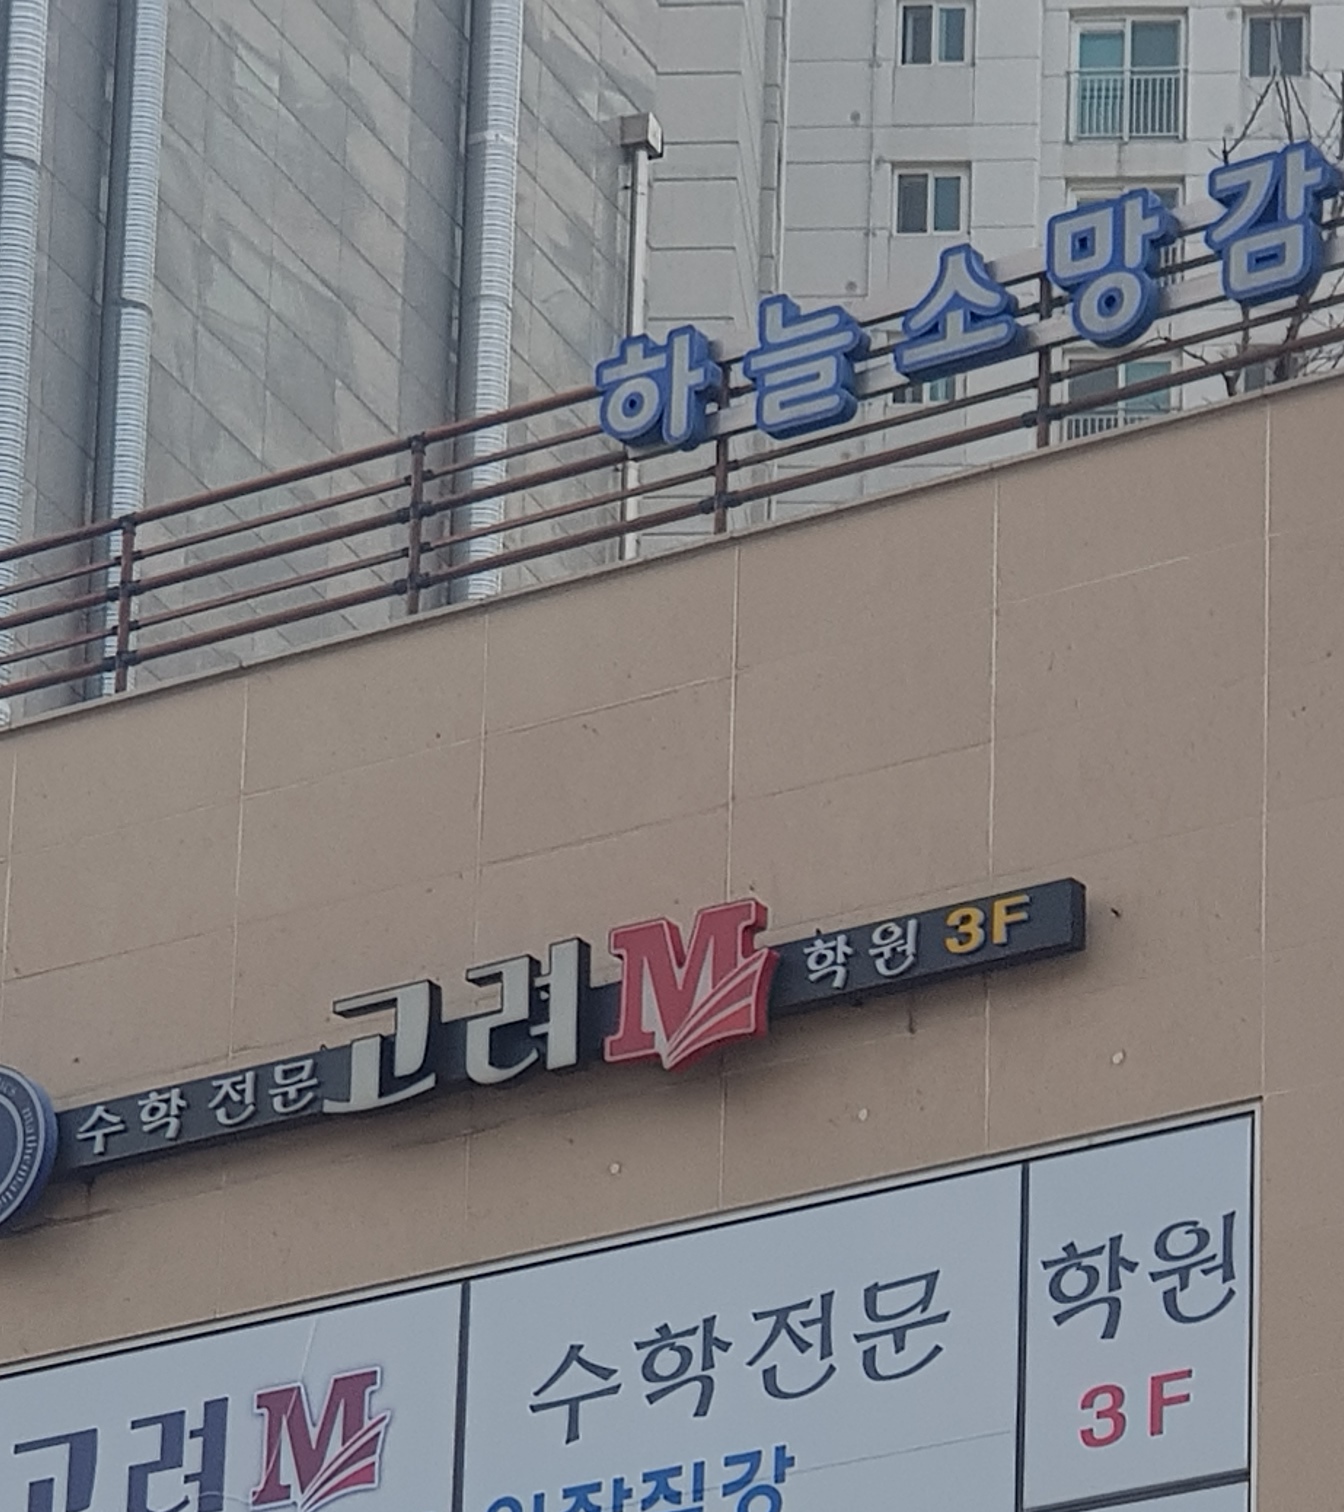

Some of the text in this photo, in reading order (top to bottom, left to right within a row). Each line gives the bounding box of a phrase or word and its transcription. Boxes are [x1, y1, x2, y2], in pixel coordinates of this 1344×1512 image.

[804, 917, 919, 989] 학원
[943, 894, 1033, 956] 3F
[1041, 1210, 1237, 1340] 학원
